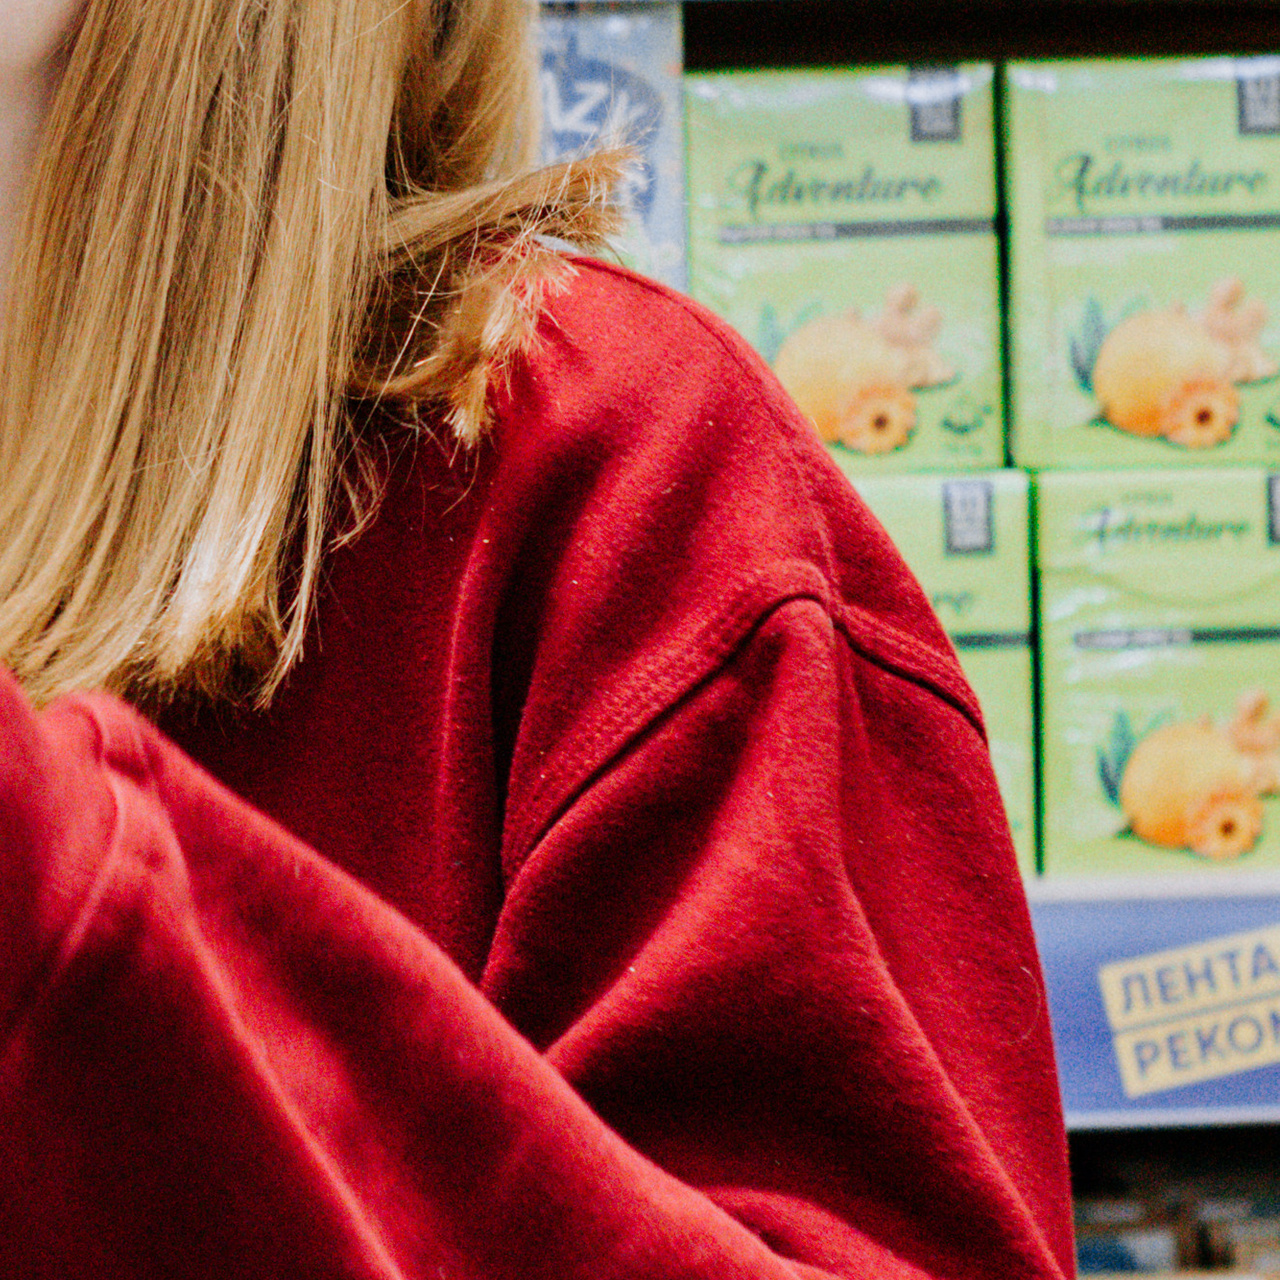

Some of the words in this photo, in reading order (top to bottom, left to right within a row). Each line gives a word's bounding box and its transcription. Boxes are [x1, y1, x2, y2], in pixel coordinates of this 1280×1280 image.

[723, 157, 942, 220] Adventure
[1050, 151, 1266, 212] Adventure
[1121, 943, 1278, 1014] ЛЕНТА
